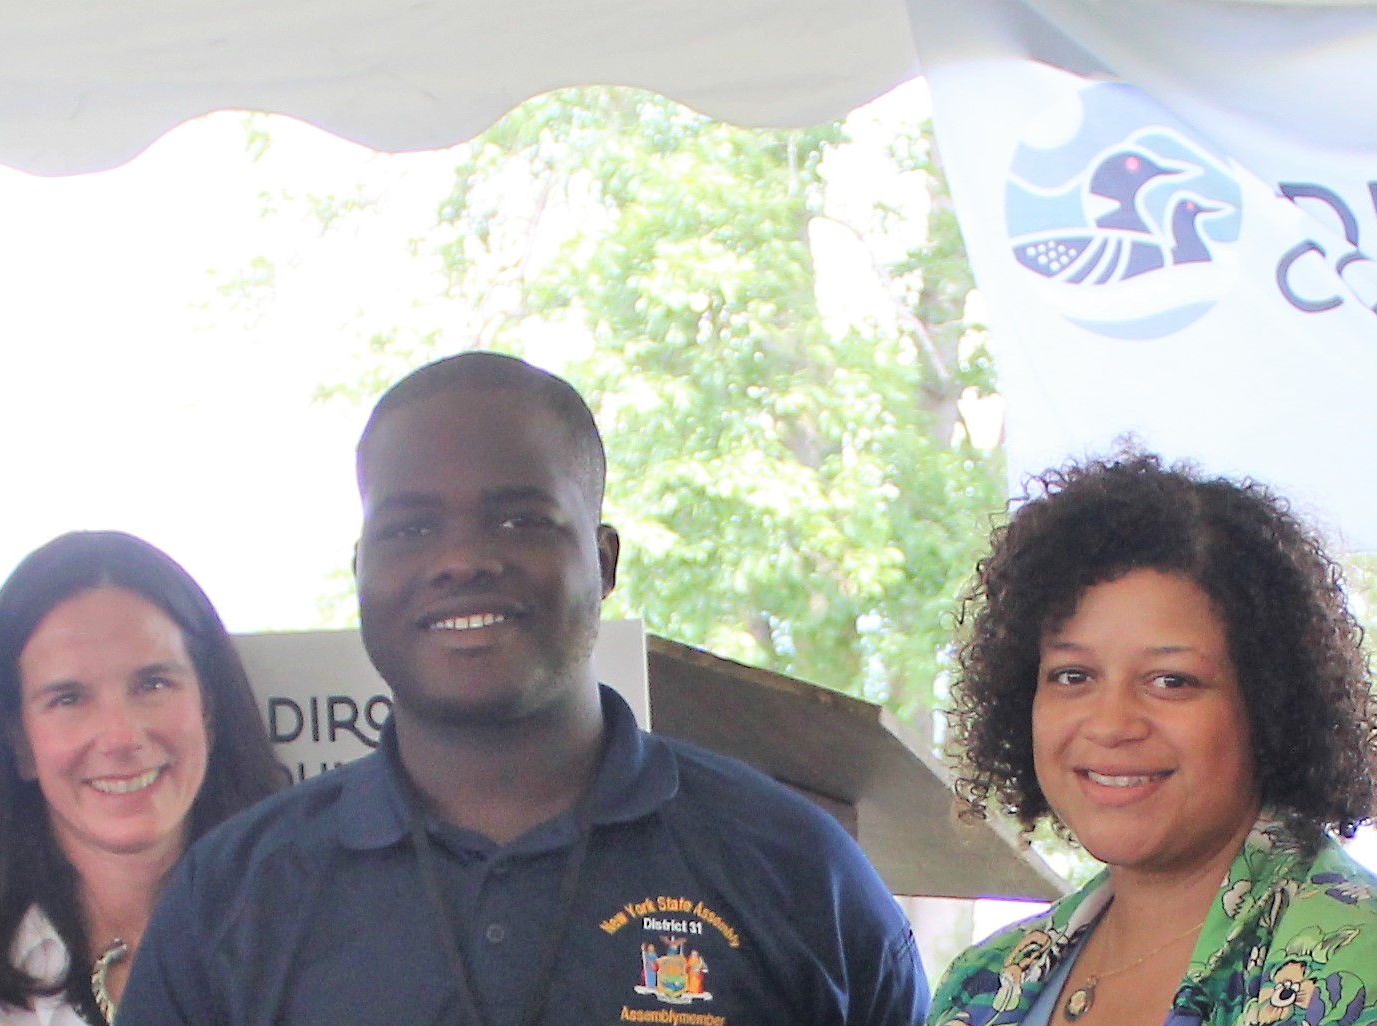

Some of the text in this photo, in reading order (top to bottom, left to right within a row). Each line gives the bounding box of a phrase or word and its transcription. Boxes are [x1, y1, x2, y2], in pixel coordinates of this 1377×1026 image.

[599, 896, 740, 948] New York State Assembly
[643, 917, 702, 935] District 31
[620, 1005, 725, 1026] Assemblymember
